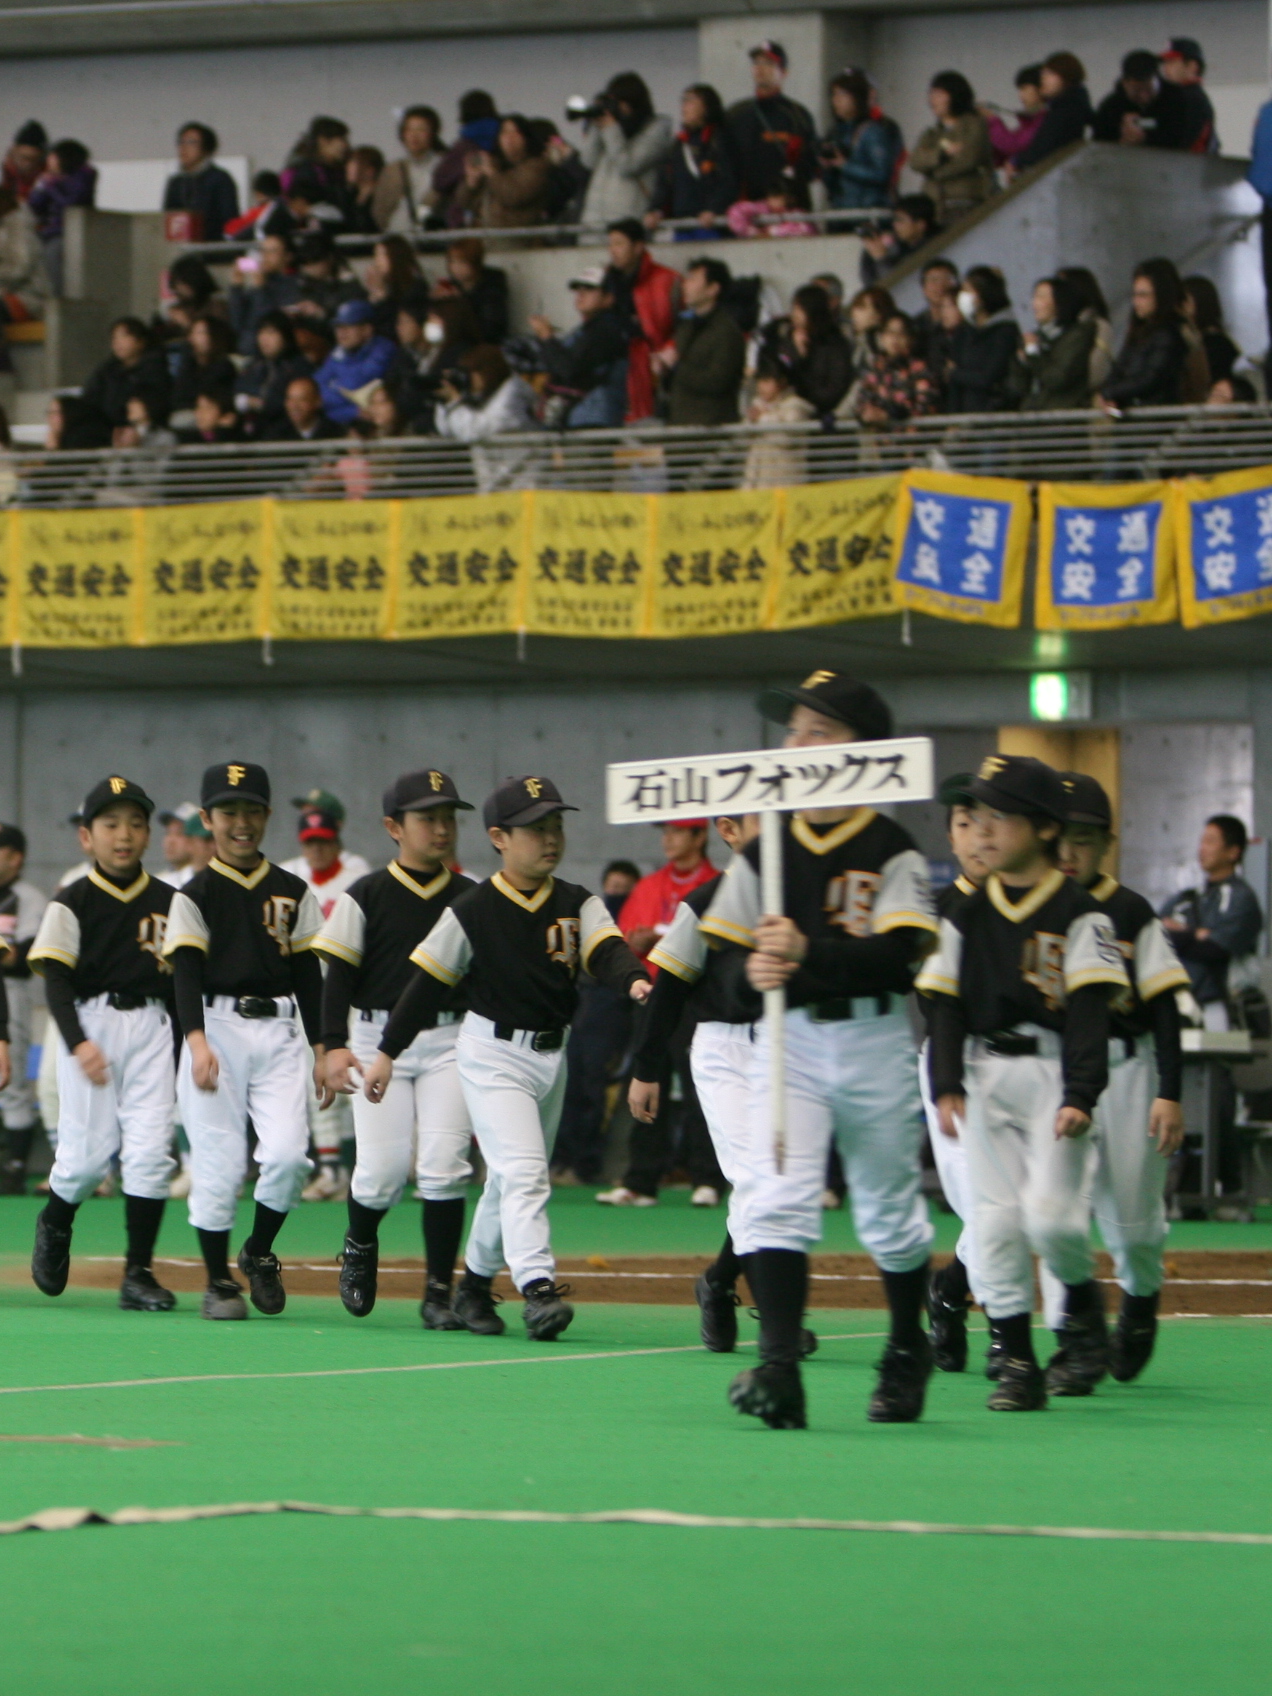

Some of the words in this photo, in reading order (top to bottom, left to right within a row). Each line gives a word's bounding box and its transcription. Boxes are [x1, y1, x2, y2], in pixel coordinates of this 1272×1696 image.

[915, 499, 998, 548] 交通
[1064, 510, 1148, 555] 交通
[153, 554, 260, 595] 交通安全
[281, 553, 385, 592] 交通安全
[407, 547, 518, 588] 交通安全
[538, 544, 641, 586] 交通安全
[662, 544, 766, 587] 交通安全
[788, 533, 893, 577] 交通安全
[912, 543, 991, 594] 安全
[28, 561, 131, 598] 交通安全
[1061, 557, 1143, 599] 安全
[624, 754, 907, 812] 石山フォックス
